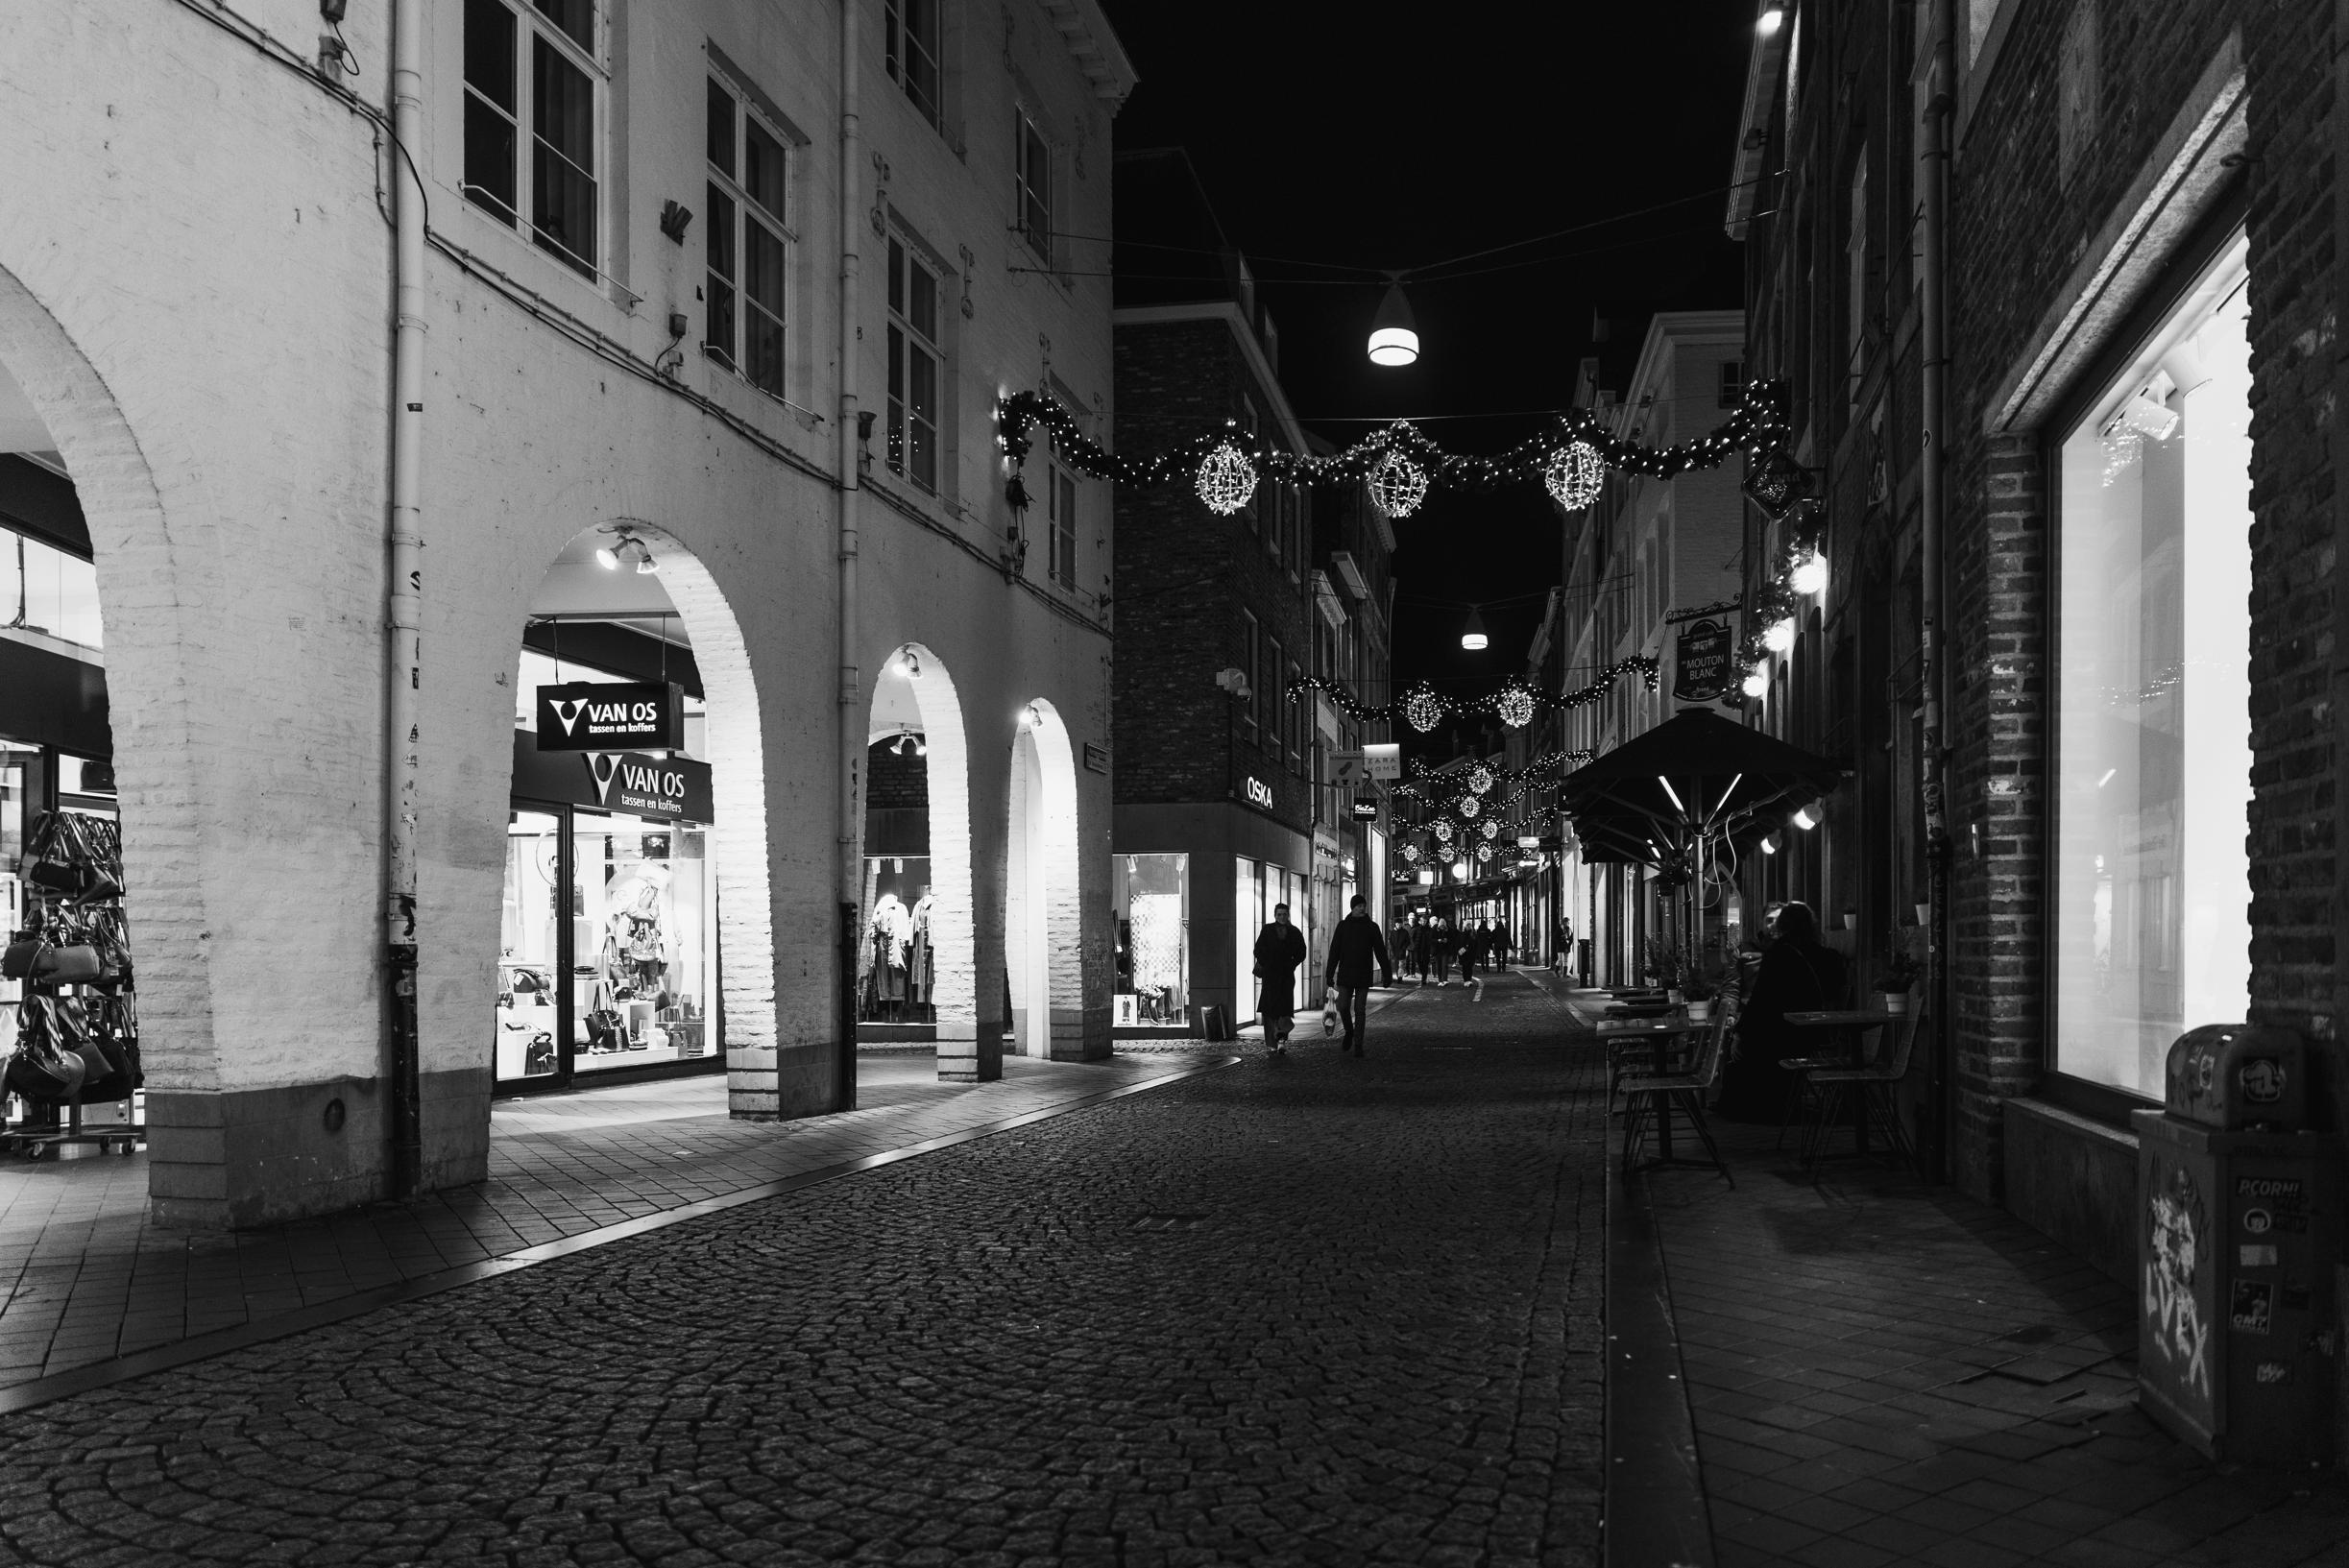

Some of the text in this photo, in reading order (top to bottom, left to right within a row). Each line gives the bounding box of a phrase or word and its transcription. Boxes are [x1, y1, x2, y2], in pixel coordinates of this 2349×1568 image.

[1686, 654, 1725, 669] MOUTON
[1689, 667, 1717, 681] BLANC
[588, 702, 657, 722] VAN OS
[589, 722, 656, 734] tassen en koffers
[622, 764, 685, 798] VAN OS
[1247, 776, 1273, 809] OSKA
[620, 793, 682, 813] tassen en koffers
